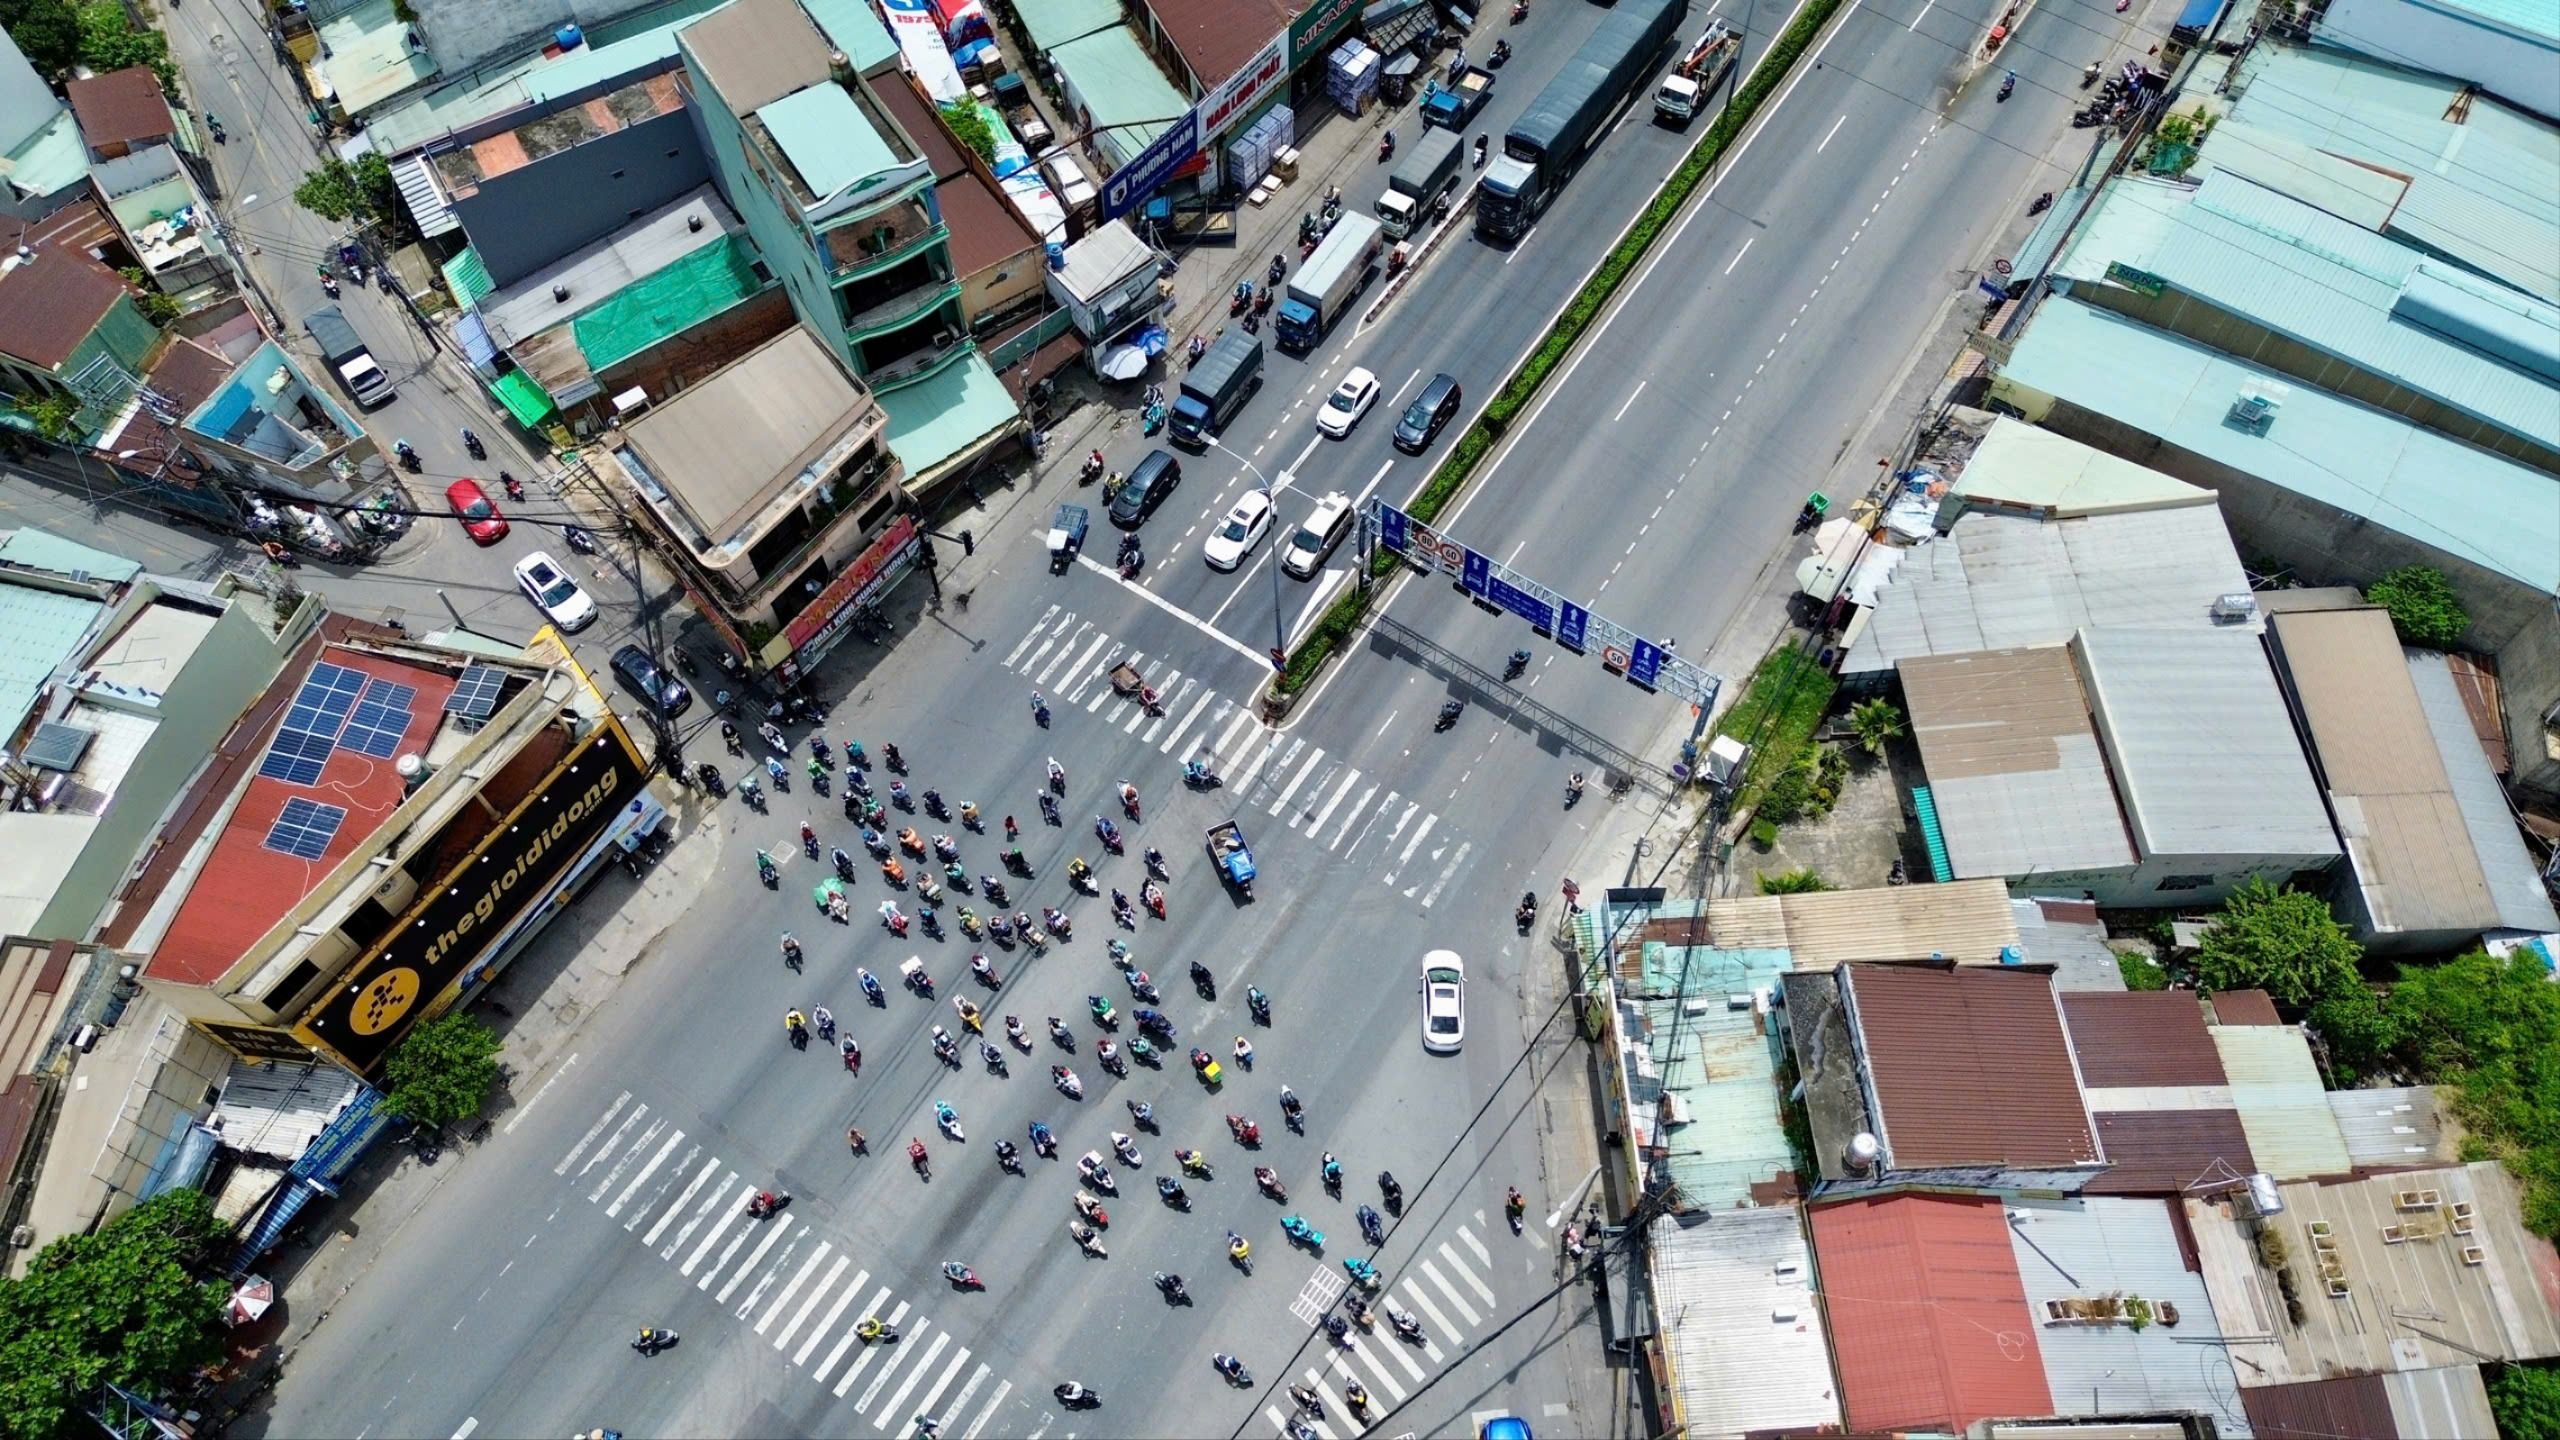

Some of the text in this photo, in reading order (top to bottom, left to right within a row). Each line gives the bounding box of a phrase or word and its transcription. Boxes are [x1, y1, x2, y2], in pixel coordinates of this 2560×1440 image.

[895, 14, 935, 24] 1975
[1297, 0, 1357, 53] MIKAD
[1171, 125, 1194, 154] NAM
[1421, 535, 1433, 547] 80
[1445, 549, 1457, 561] 60
[856, 574, 883, 605] QUANG
[1611, 652, 1624, 665] 50
[425, 766, 618, 965] thegioididong
